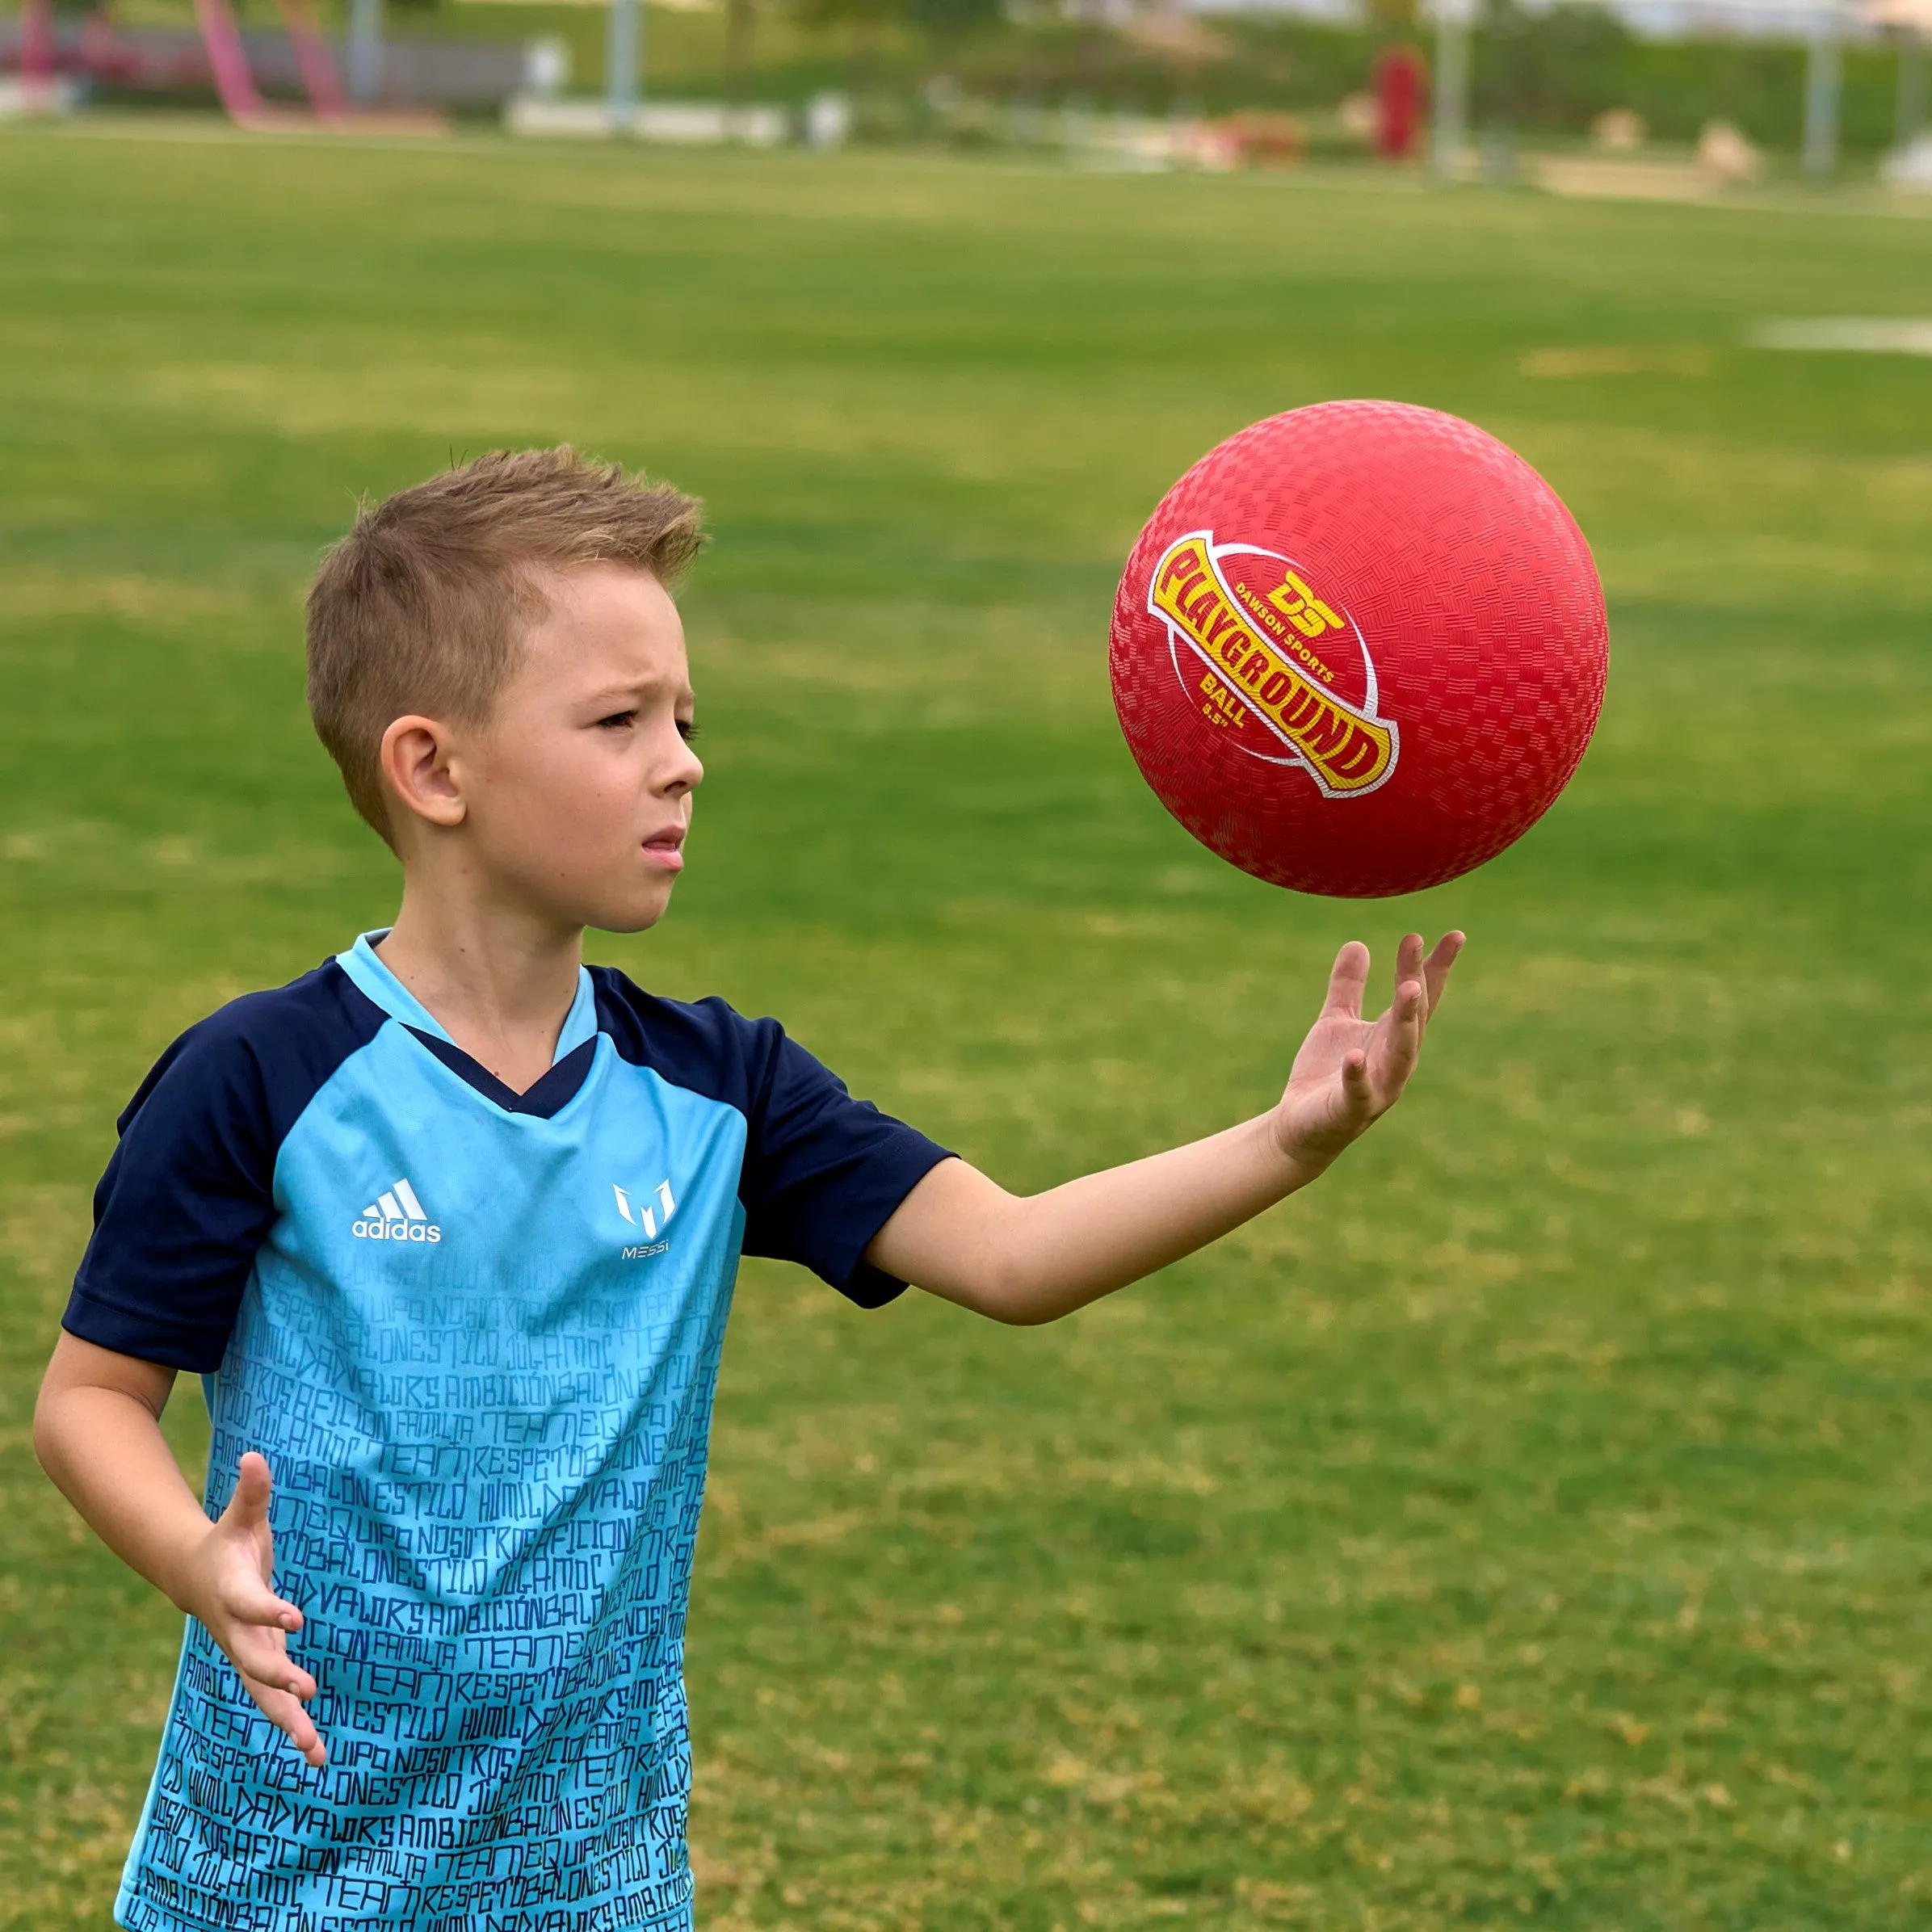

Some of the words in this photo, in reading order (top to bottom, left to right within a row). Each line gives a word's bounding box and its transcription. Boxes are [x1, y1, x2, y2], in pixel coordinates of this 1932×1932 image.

[1160, 548, 1380, 779] PLAYGROUND
[1235, 582, 1283, 636] DAWSON
[1284, 634, 1335, 683] SPORTS
[1199, 673, 1246, 729] BALL
[352, 1216, 441, 1243] adidas
